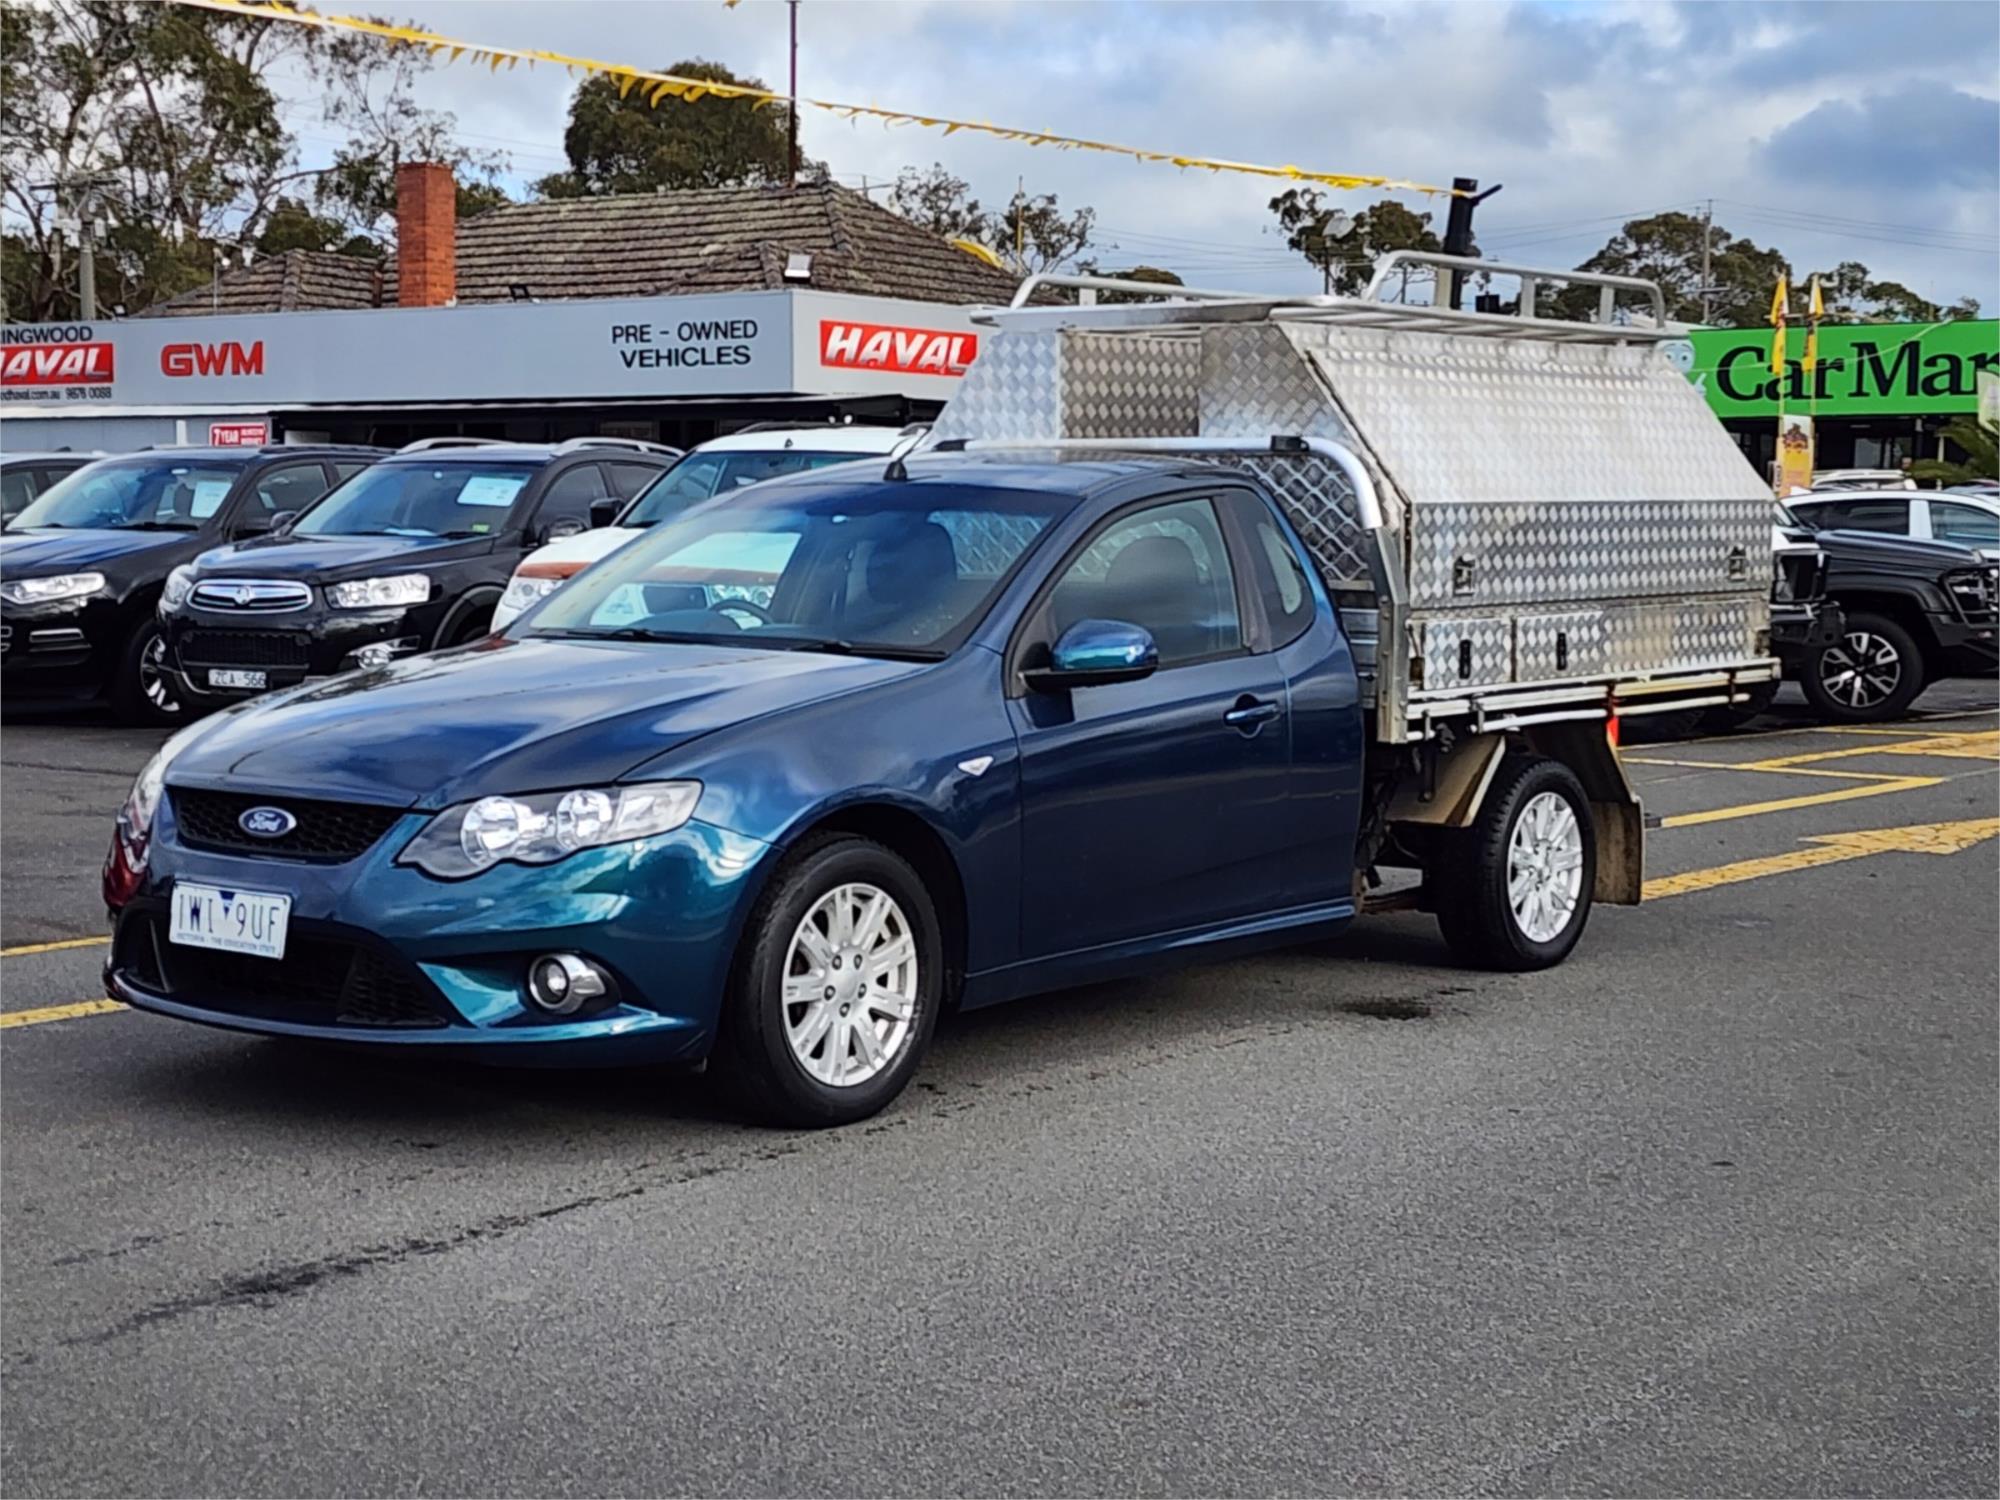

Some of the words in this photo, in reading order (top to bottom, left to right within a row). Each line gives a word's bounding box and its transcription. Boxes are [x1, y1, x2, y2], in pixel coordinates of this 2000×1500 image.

[1, 326, 93, 343] INGWOOD
[611, 325, 651, 344] PRE
[677, 320, 758, 342] OWNED
[161, 341, 263, 377] GWM
[620, 345, 751, 369] VEHICLES
[825, 325, 970, 371] HAVAL
[1716, 345, 1845, 401] Car
[248, 812, 282, 832] Ford
[235, 902, 281, 943] 9UF
